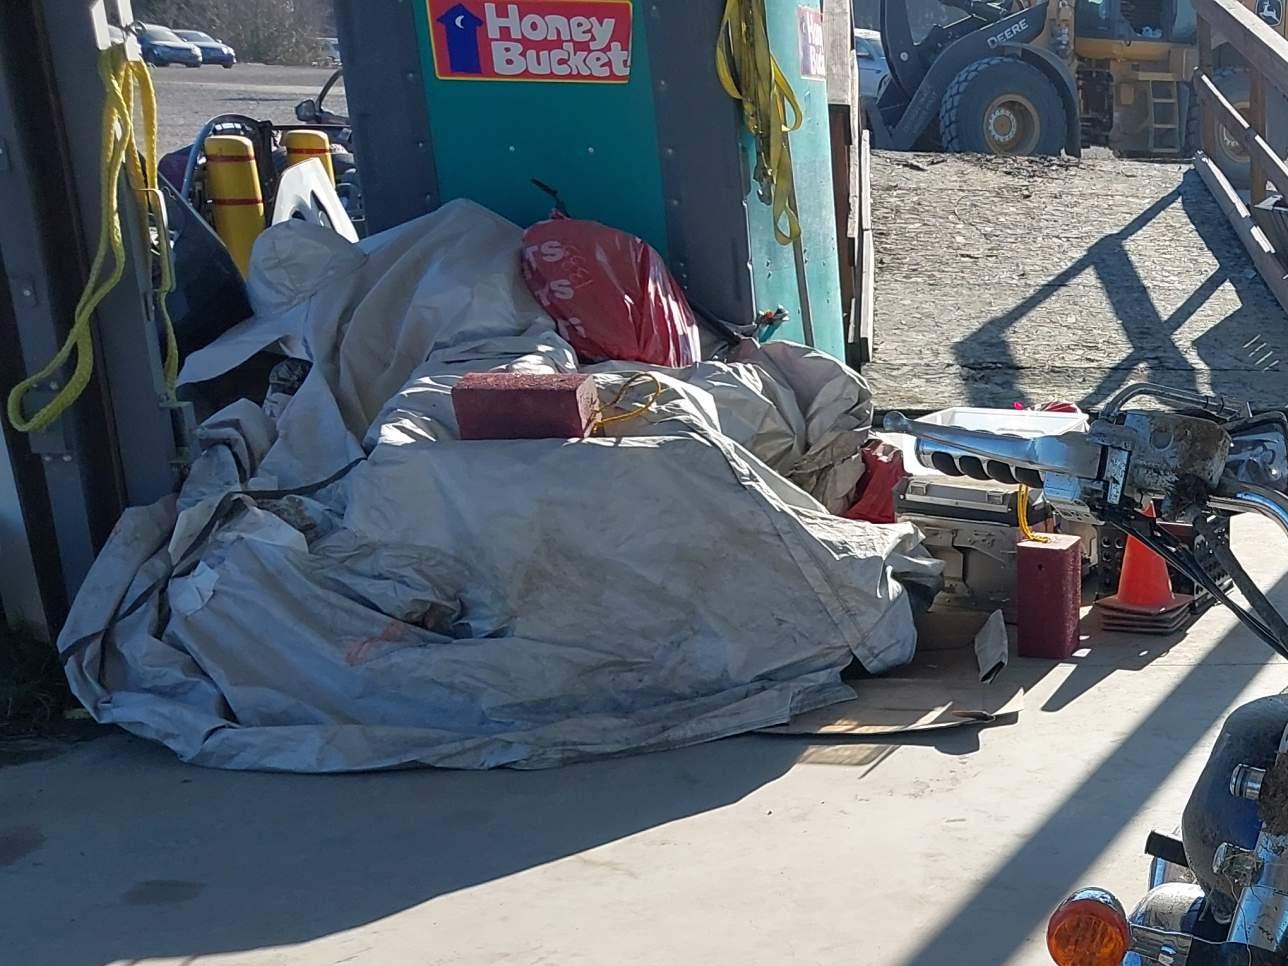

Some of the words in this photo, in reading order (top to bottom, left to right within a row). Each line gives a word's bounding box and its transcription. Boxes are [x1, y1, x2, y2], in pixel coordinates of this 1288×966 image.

[485, 3, 615, 50] Honey
[986, 18, 1030, 49] DEERE
[490, 41, 630, 76] Bucket
